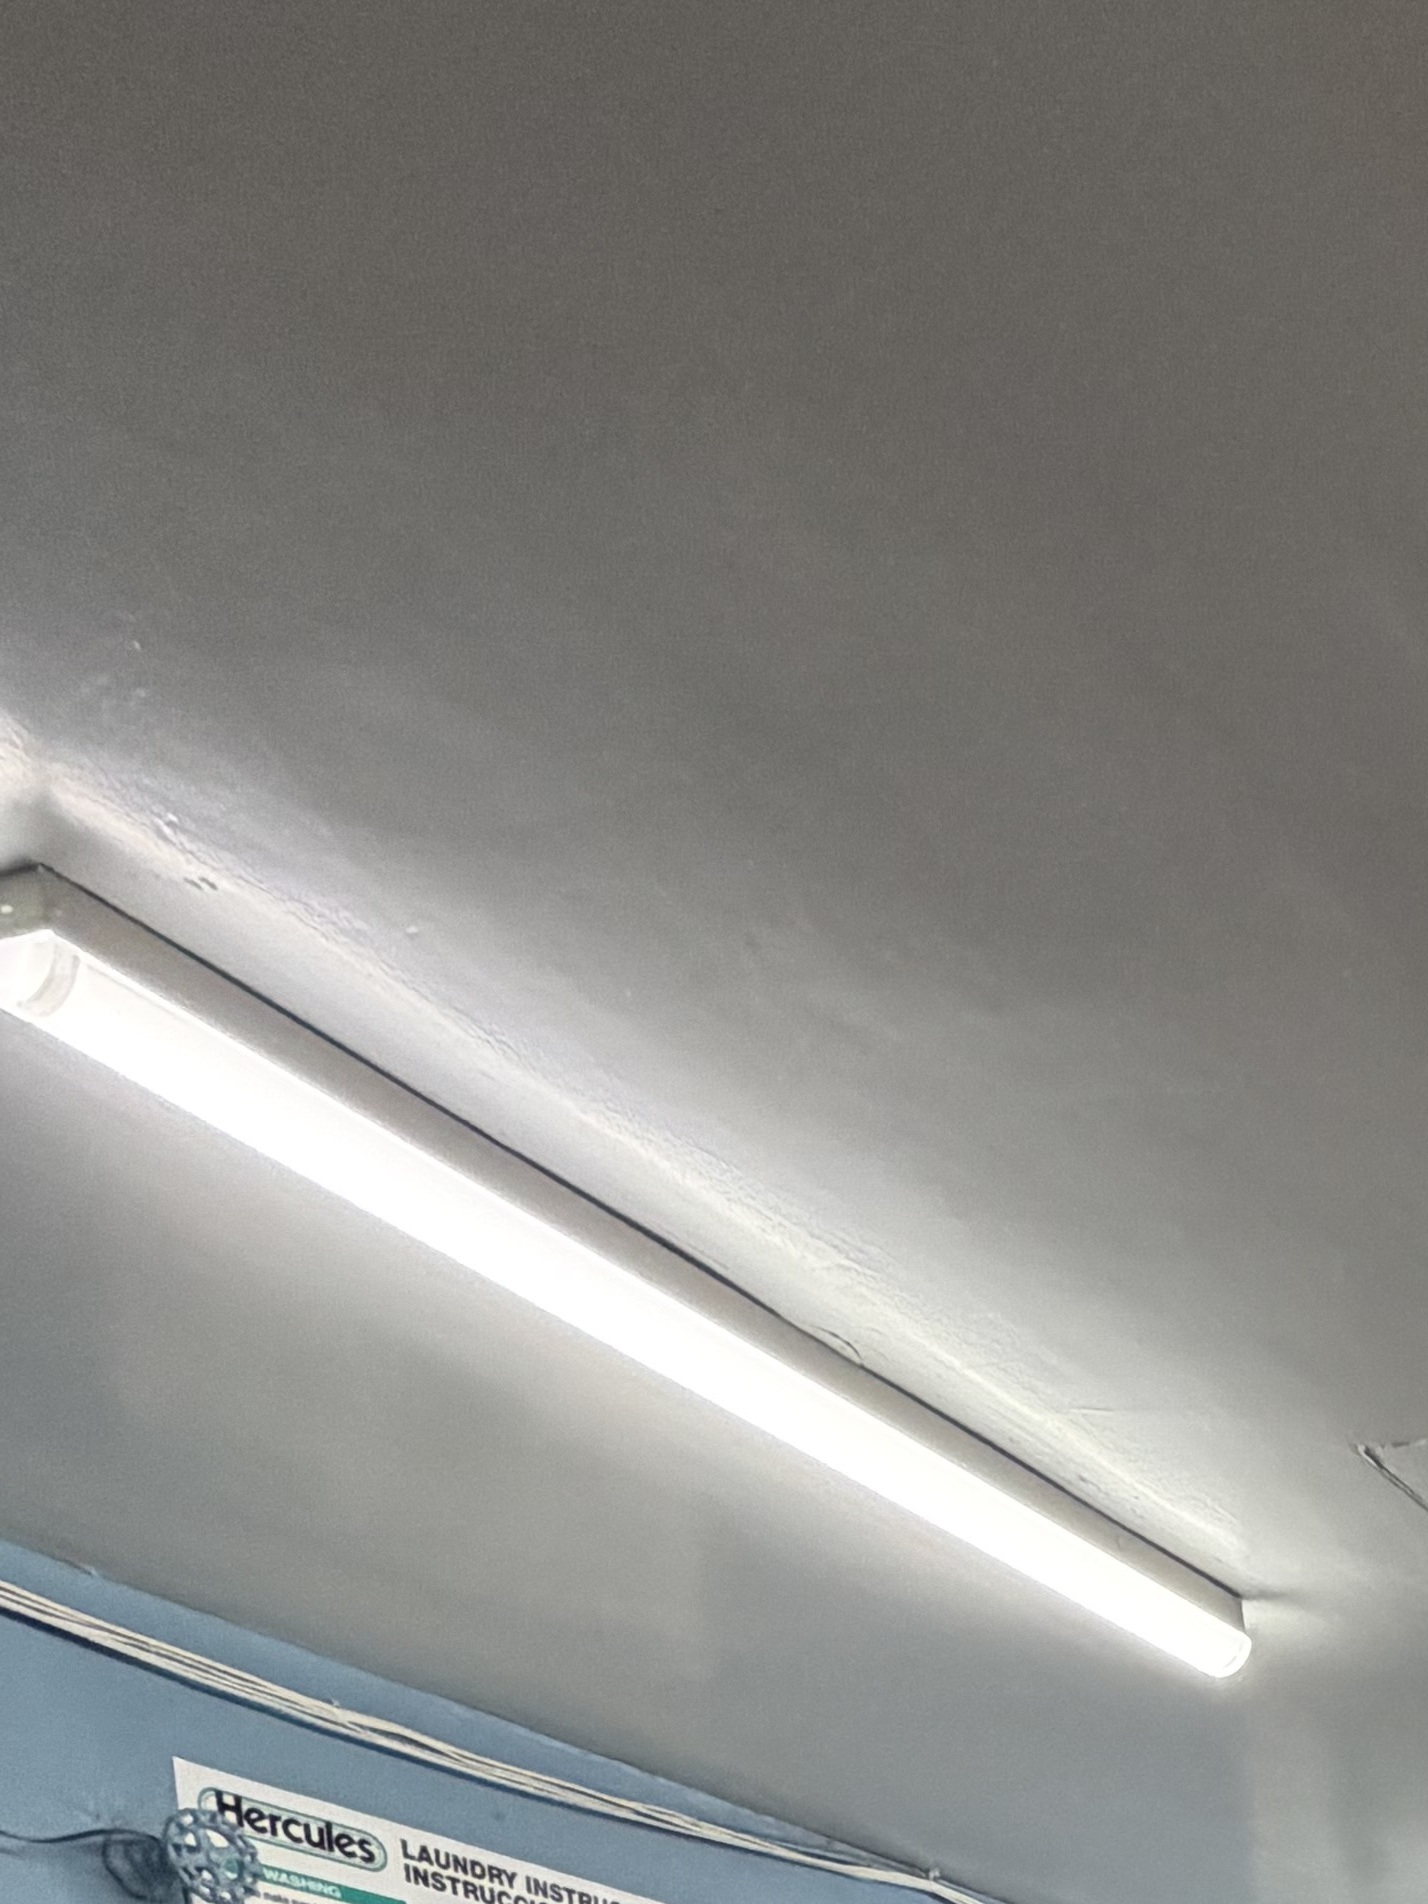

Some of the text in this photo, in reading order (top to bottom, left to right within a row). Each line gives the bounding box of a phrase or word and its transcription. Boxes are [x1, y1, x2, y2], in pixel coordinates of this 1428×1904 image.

[214, 1790, 376, 1863] Hercules
[262, 1867, 343, 1899] WASHING
[400, 1839, 518, 1888] LAUNDRY
